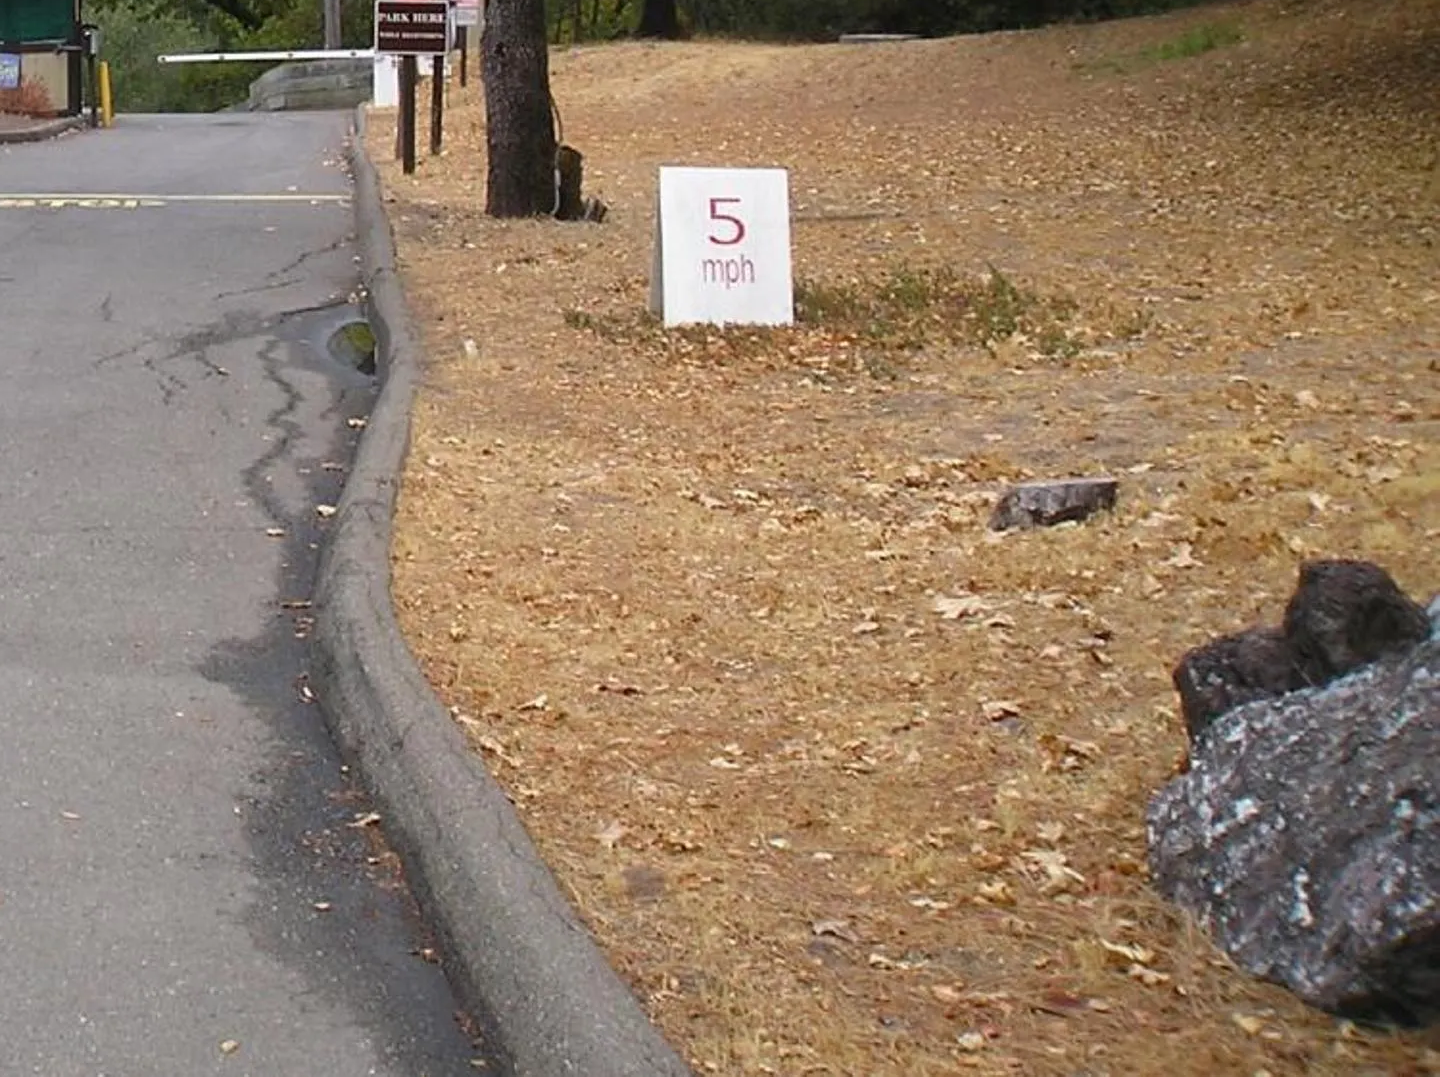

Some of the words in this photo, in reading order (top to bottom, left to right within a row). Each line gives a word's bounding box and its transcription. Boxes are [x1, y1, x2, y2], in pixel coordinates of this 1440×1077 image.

[378, 13, 409, 23] PARK
[413, 13, 444, 24] HERE
[709, 198, 745, 245] 5
[702, 254, 755, 290] mph
